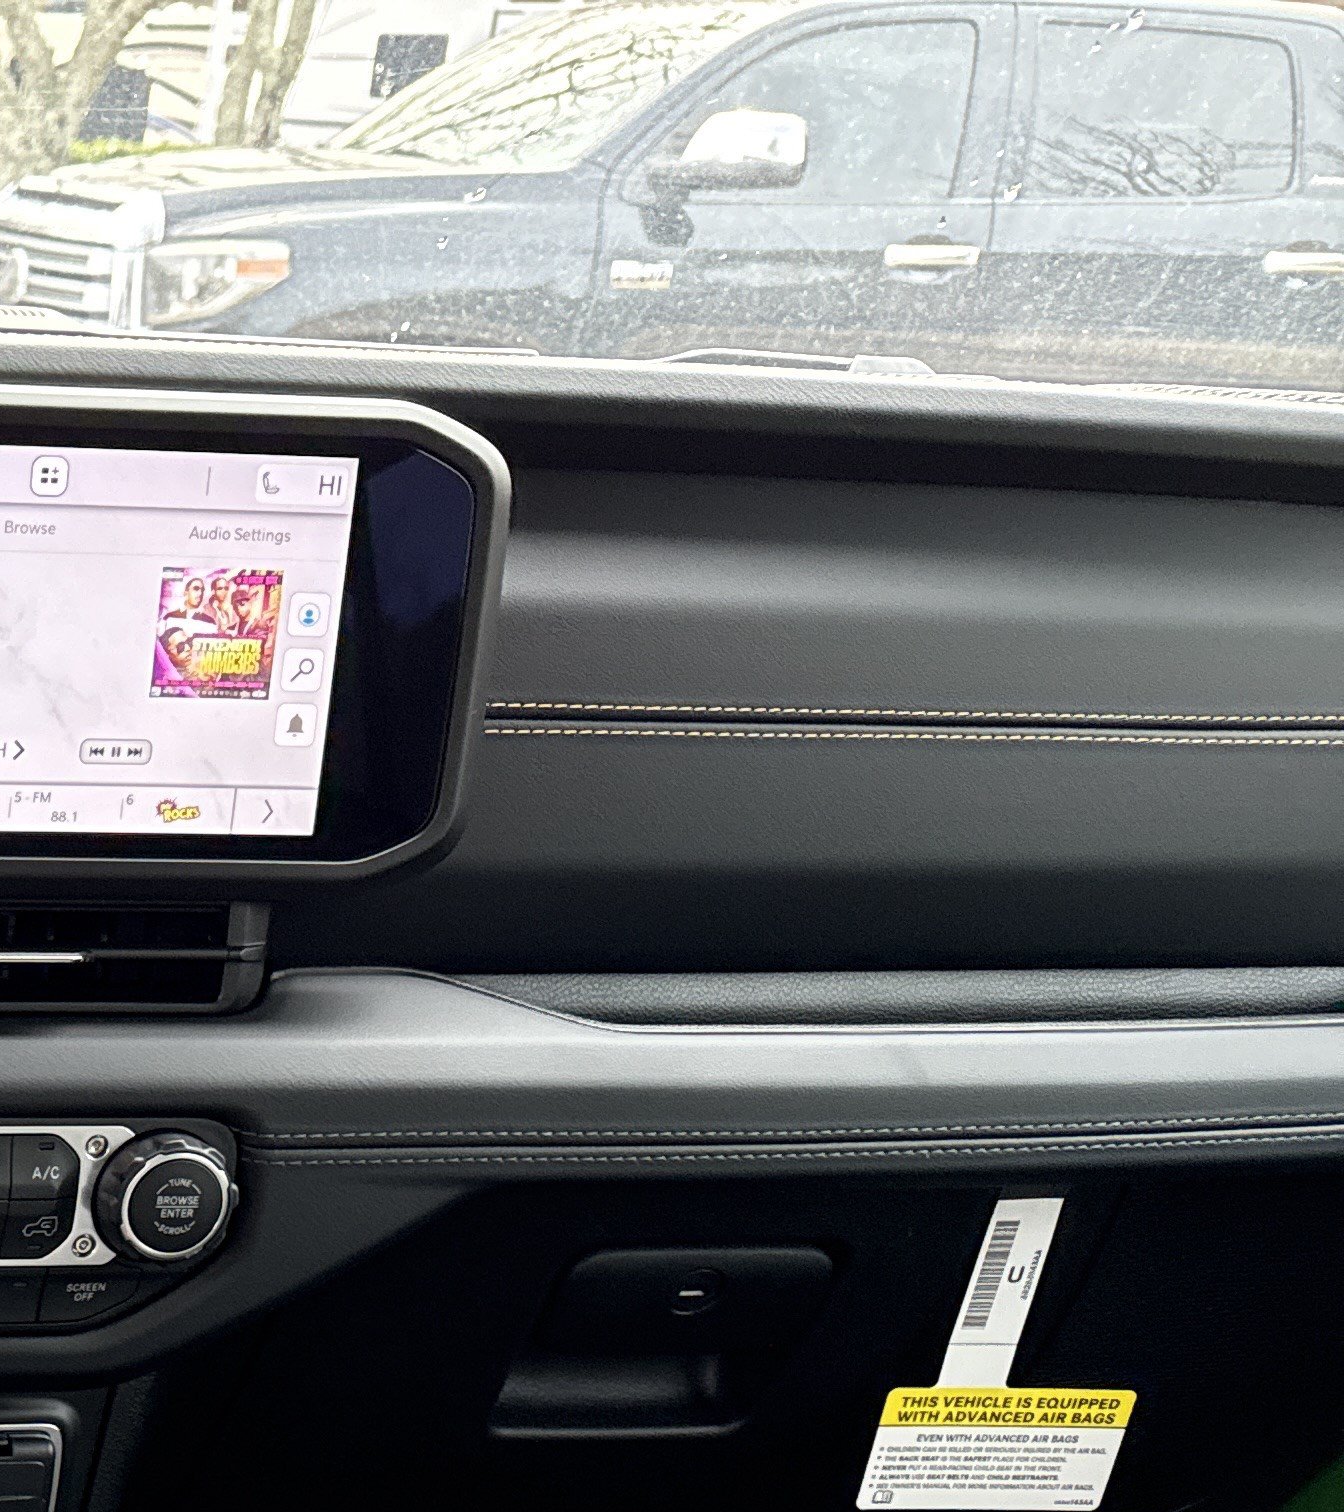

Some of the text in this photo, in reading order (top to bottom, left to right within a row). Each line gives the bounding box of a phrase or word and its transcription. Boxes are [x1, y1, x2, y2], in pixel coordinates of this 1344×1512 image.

[318, 476, 342, 496] HI
[4, 520, 56, 536] Browse
[189, 526, 291, 545] Audio Settings
[14, 792, 52, 803] 5 FM
[126, 794, 134, 805] 6
[51, 811, 78, 823] 88.1
[32, 1165, 60, 1180] A/C
[170, 1178, 193, 1188] TUNE
[156, 1196, 199, 1206] BROWSE
[160, 1208, 194, 1219] ENTER
[157, 1223, 191, 1235] SCROLL
[1008, 1266, 1025, 1283] U
[66, 1283, 106, 1292] SCREEN
[74, 1292, 94, 1302] OFF
[901, 1396, 1120, 1410] THIS VEHICLE IS EQUIPPED
[898, 1411, 1116, 1425] WITH ADVANCED AIR BAGS
[917, 1434, 1079, 1443] EVEN WITH ADVANCED AIR BAGS
